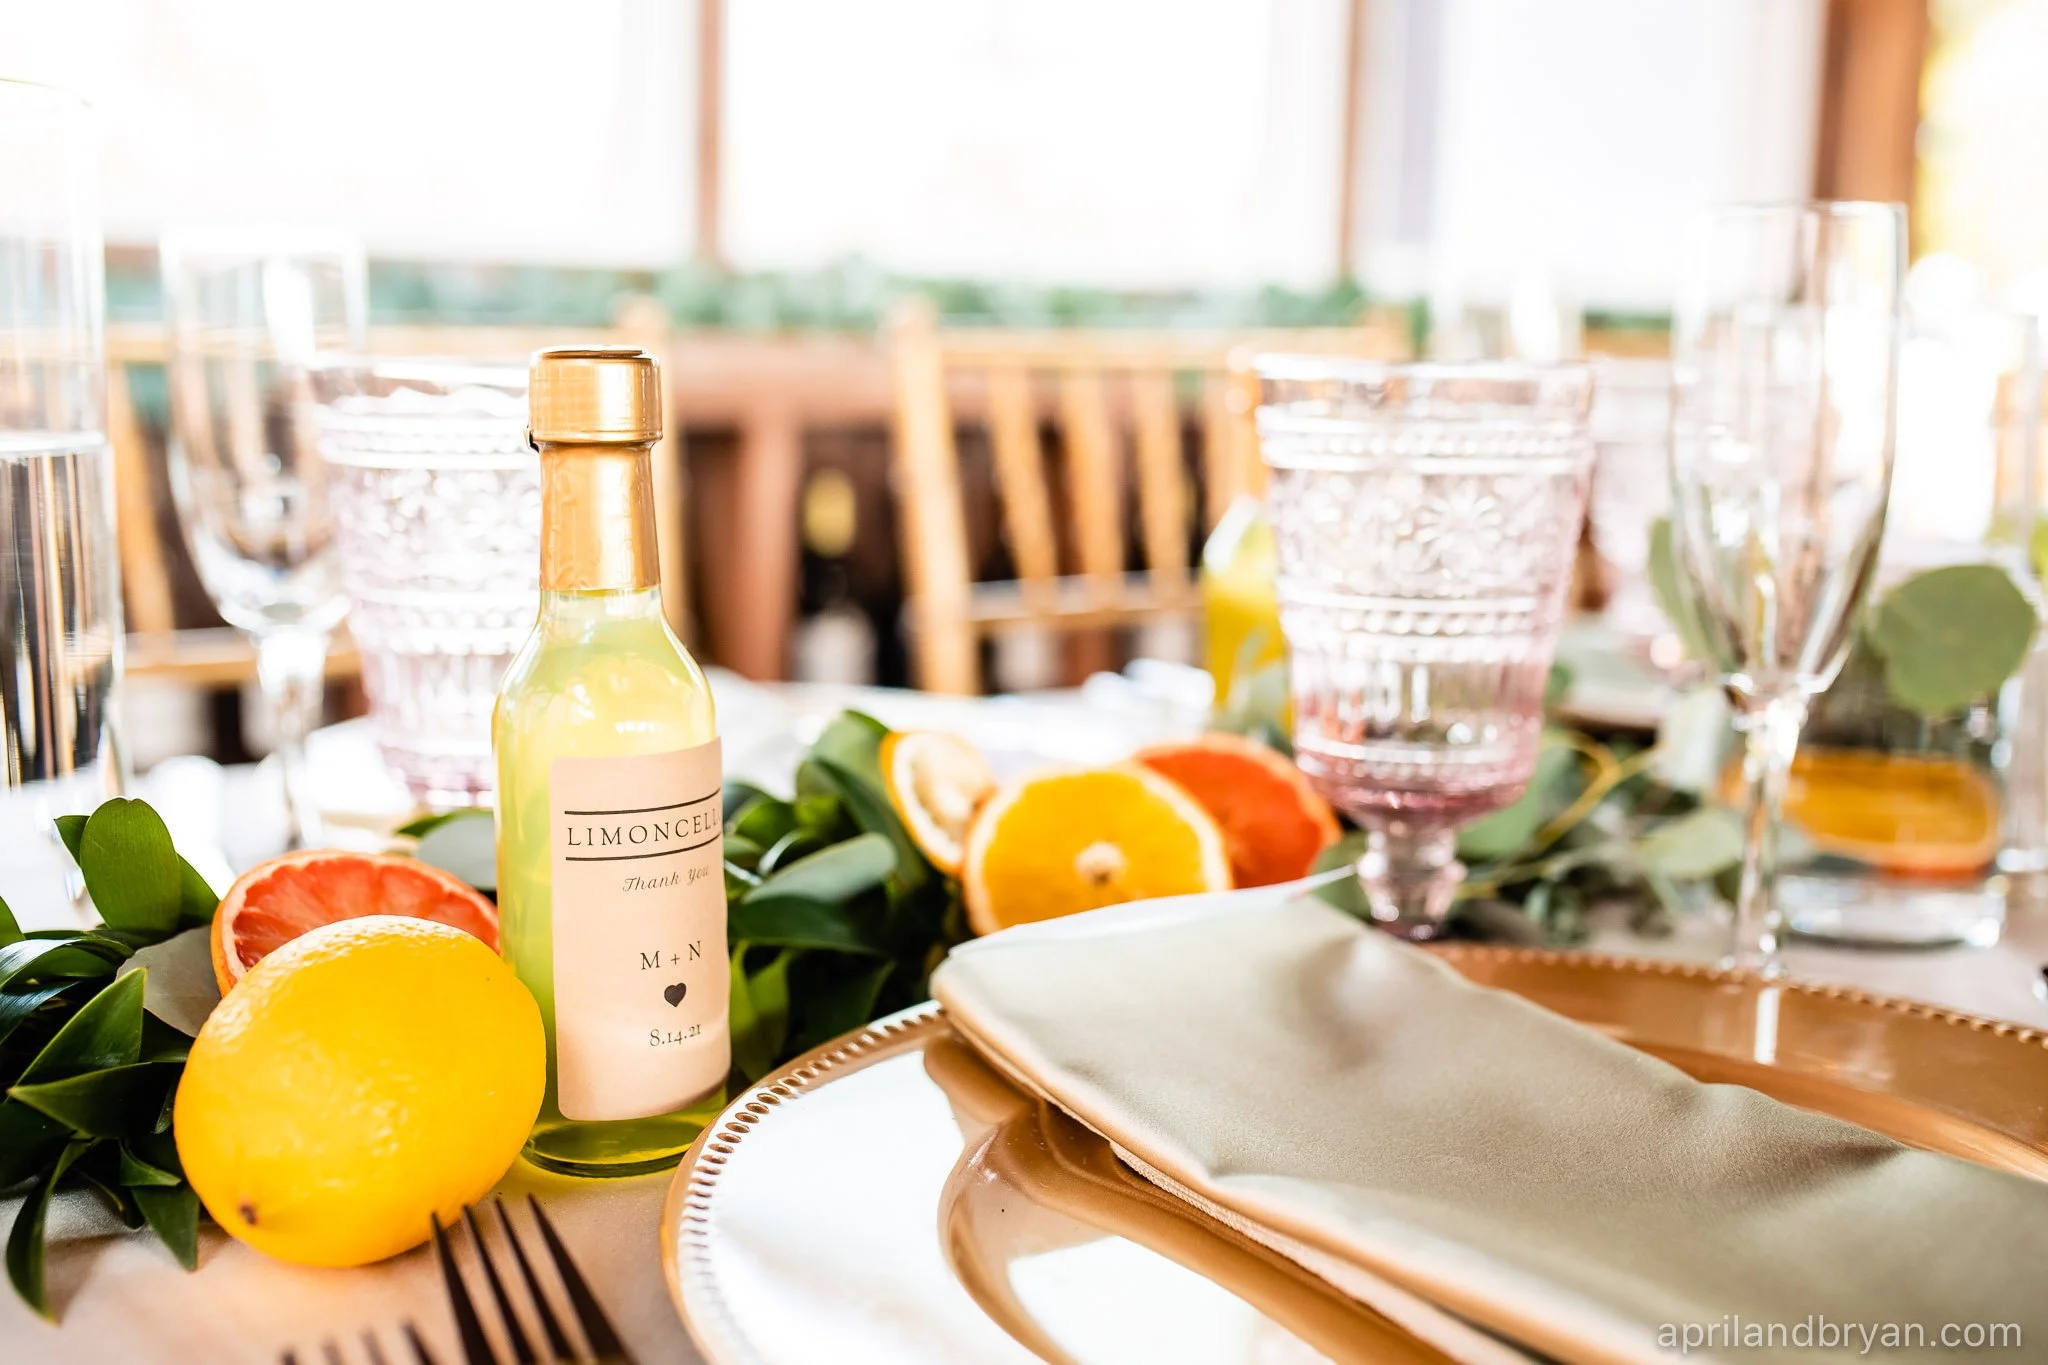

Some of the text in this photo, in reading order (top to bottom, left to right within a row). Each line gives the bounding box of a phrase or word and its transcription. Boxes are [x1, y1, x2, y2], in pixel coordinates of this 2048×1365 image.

[622, 871, 681, 892] Thank
[640, 950, 660, 970] M
[688, 940, 703, 961] N
[649, 1024, 701, 1047] 8.14.21
